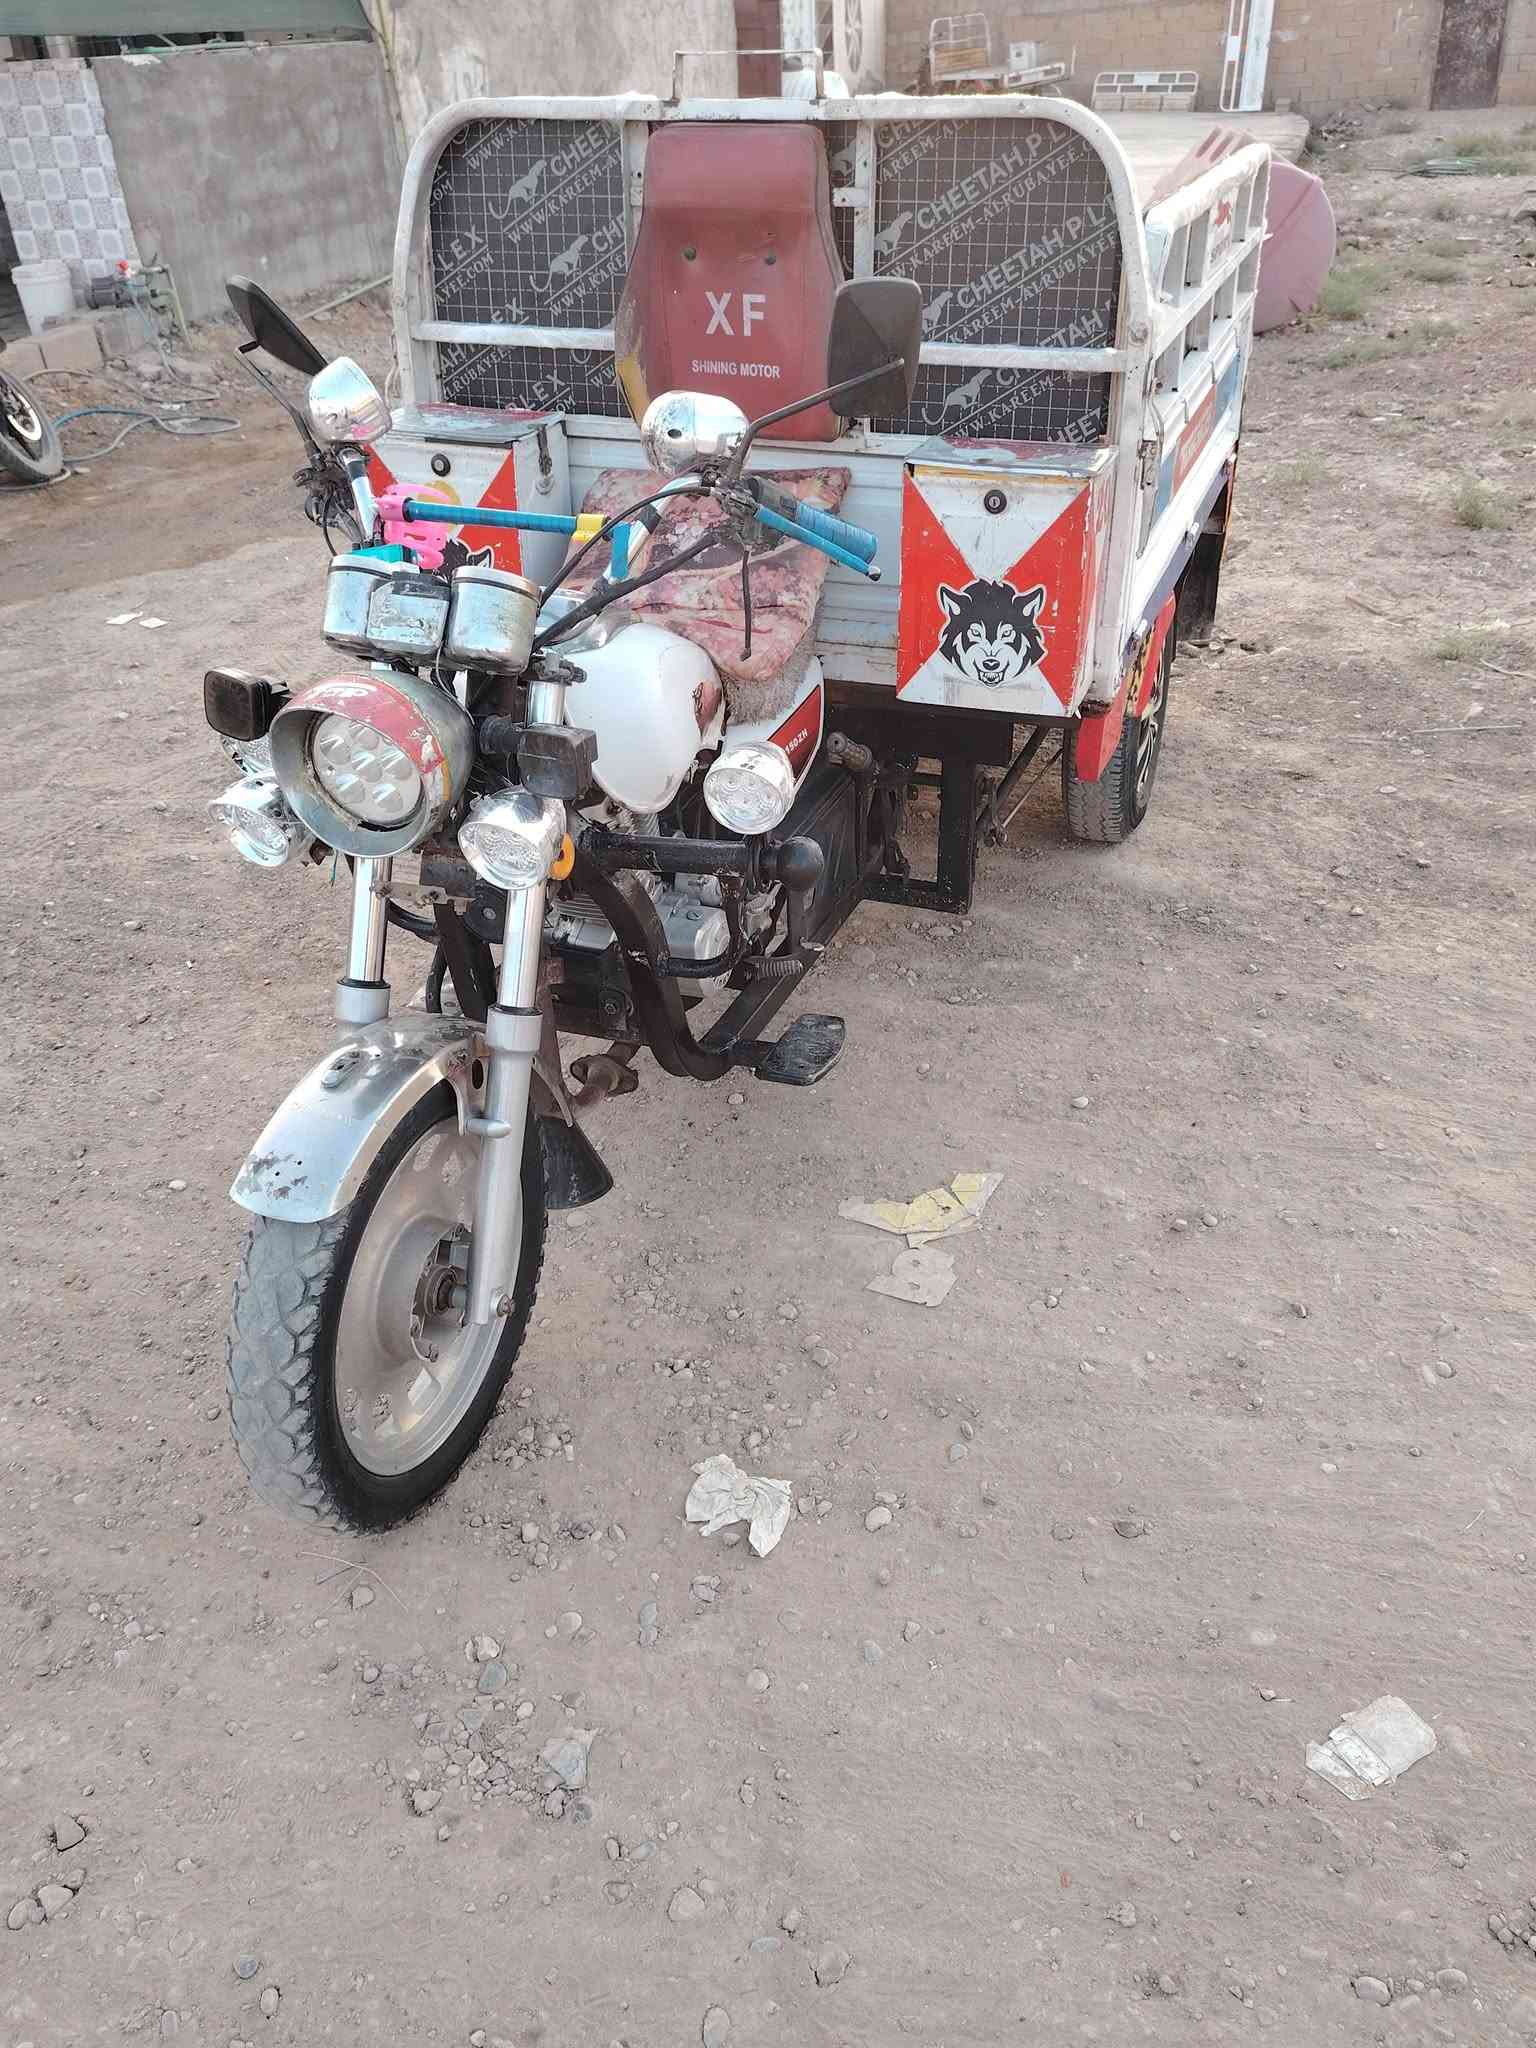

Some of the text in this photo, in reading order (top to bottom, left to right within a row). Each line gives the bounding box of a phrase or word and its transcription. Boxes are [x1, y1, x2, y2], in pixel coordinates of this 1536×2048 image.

[916, 144, 1025, 230] CHEETAH
[957, 229, 1065, 308] CHEETAH
[692, 359, 781, 379] SHINING MOTOR
